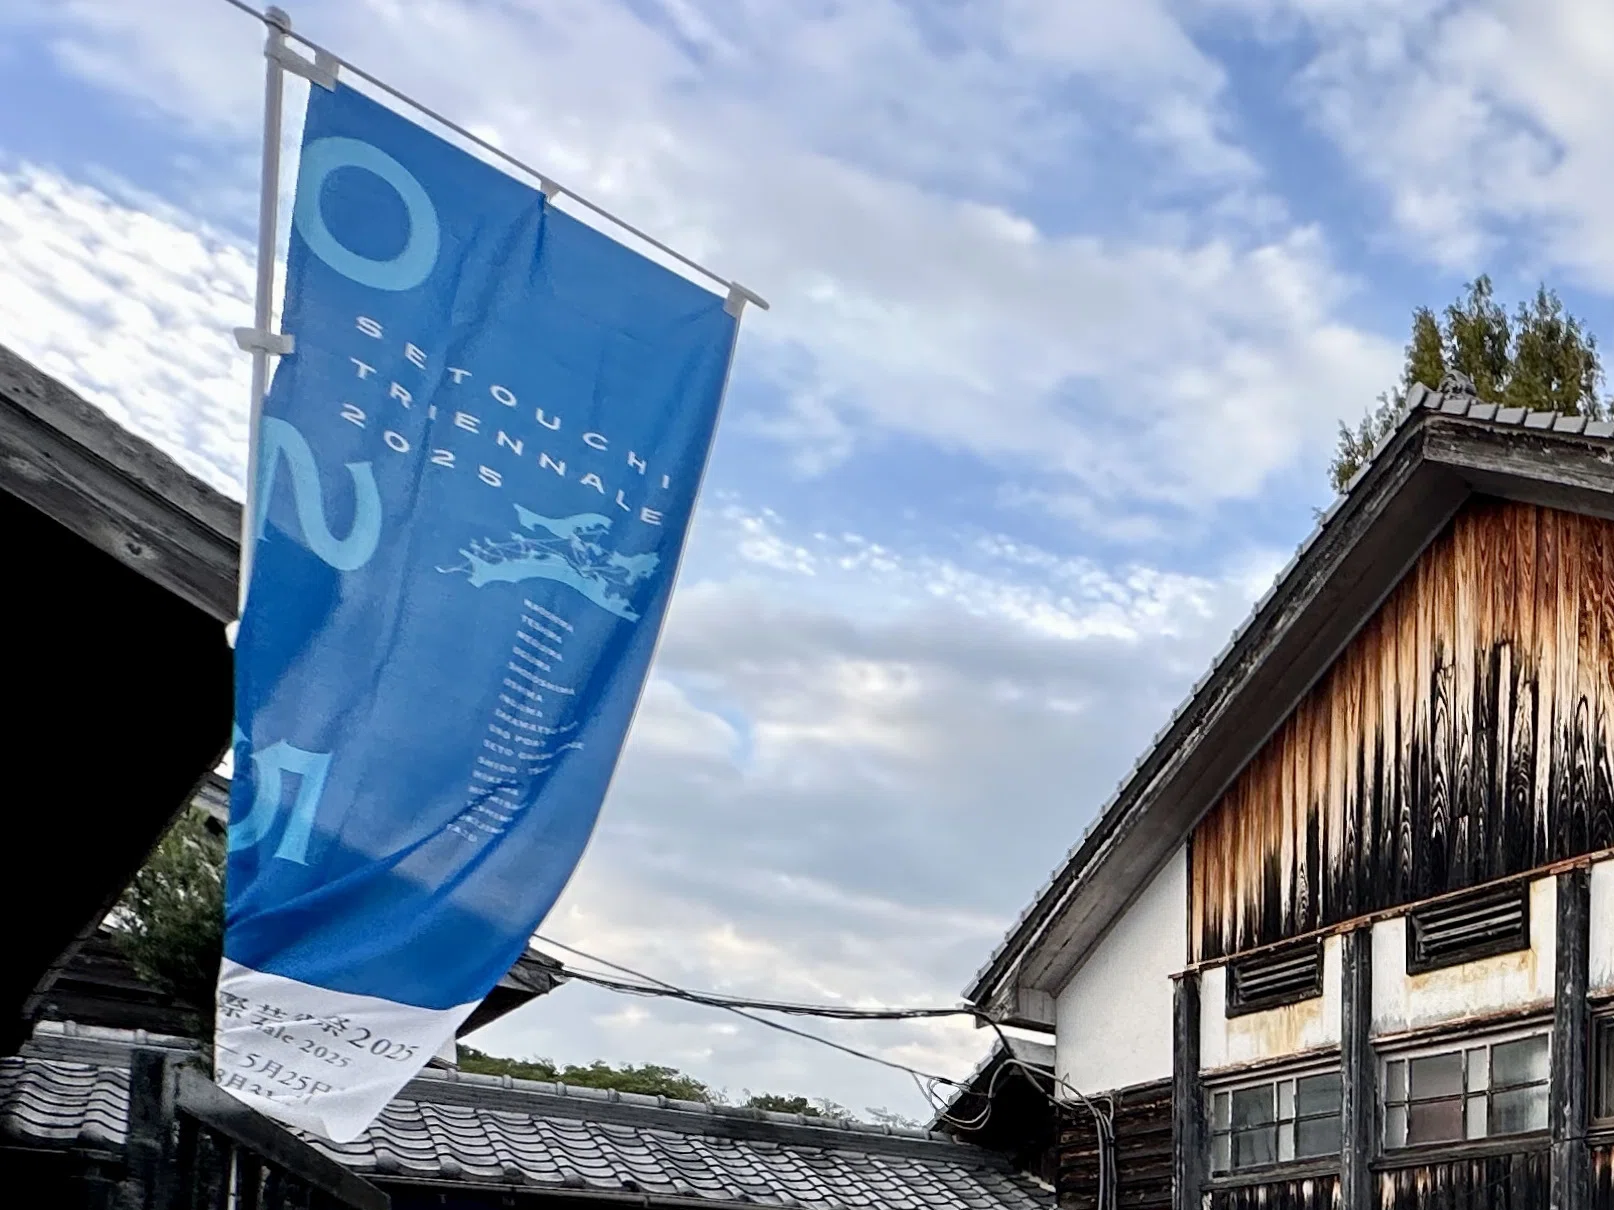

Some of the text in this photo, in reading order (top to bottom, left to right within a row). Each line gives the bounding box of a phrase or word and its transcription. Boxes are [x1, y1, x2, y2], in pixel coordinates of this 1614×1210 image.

[340, 403, 502, 488] 2025
[350, 357, 663, 526] TRIENNALE
[355, 315, 669, 489] SETOUCHI
[299, 1039, 354, 1068] 2025
